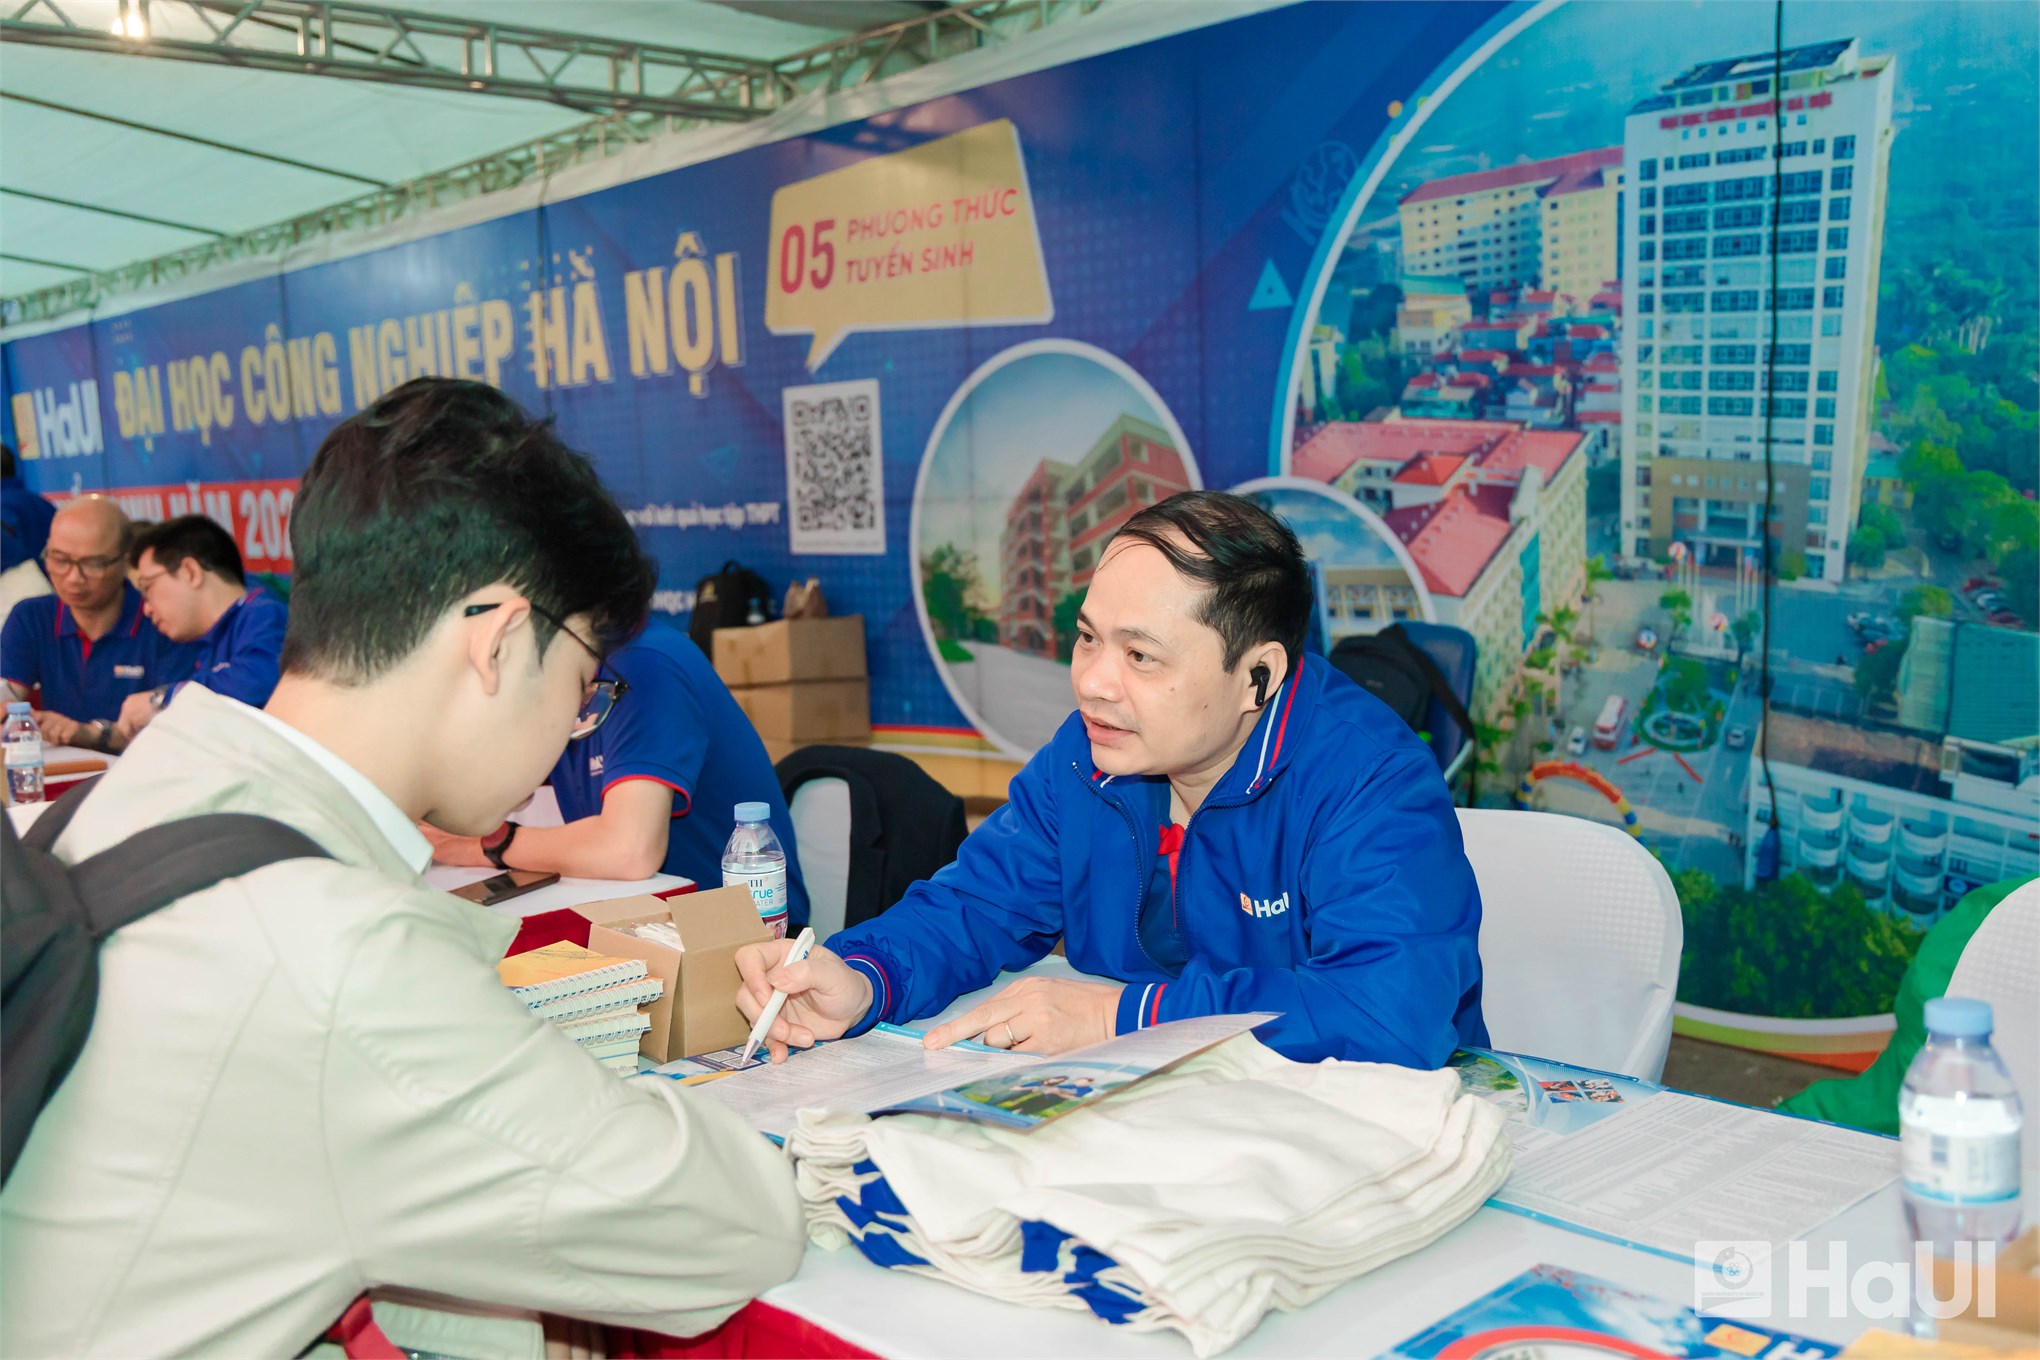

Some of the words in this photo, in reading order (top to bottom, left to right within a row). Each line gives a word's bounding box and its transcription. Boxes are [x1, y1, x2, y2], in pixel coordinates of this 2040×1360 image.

[781, 219, 836, 294] 05
[920, 241, 975, 274] SINH
[113, 365, 165, 452] ĐẠI
[167, 351, 235, 447] HỌC
[240, 322, 343, 425] CÔNG
[624, 231, 746, 398] NỘI
[34, 379, 104, 459] HaUI
[750, 888, 774, 899] rue
[754, 899, 774, 907] ATER
